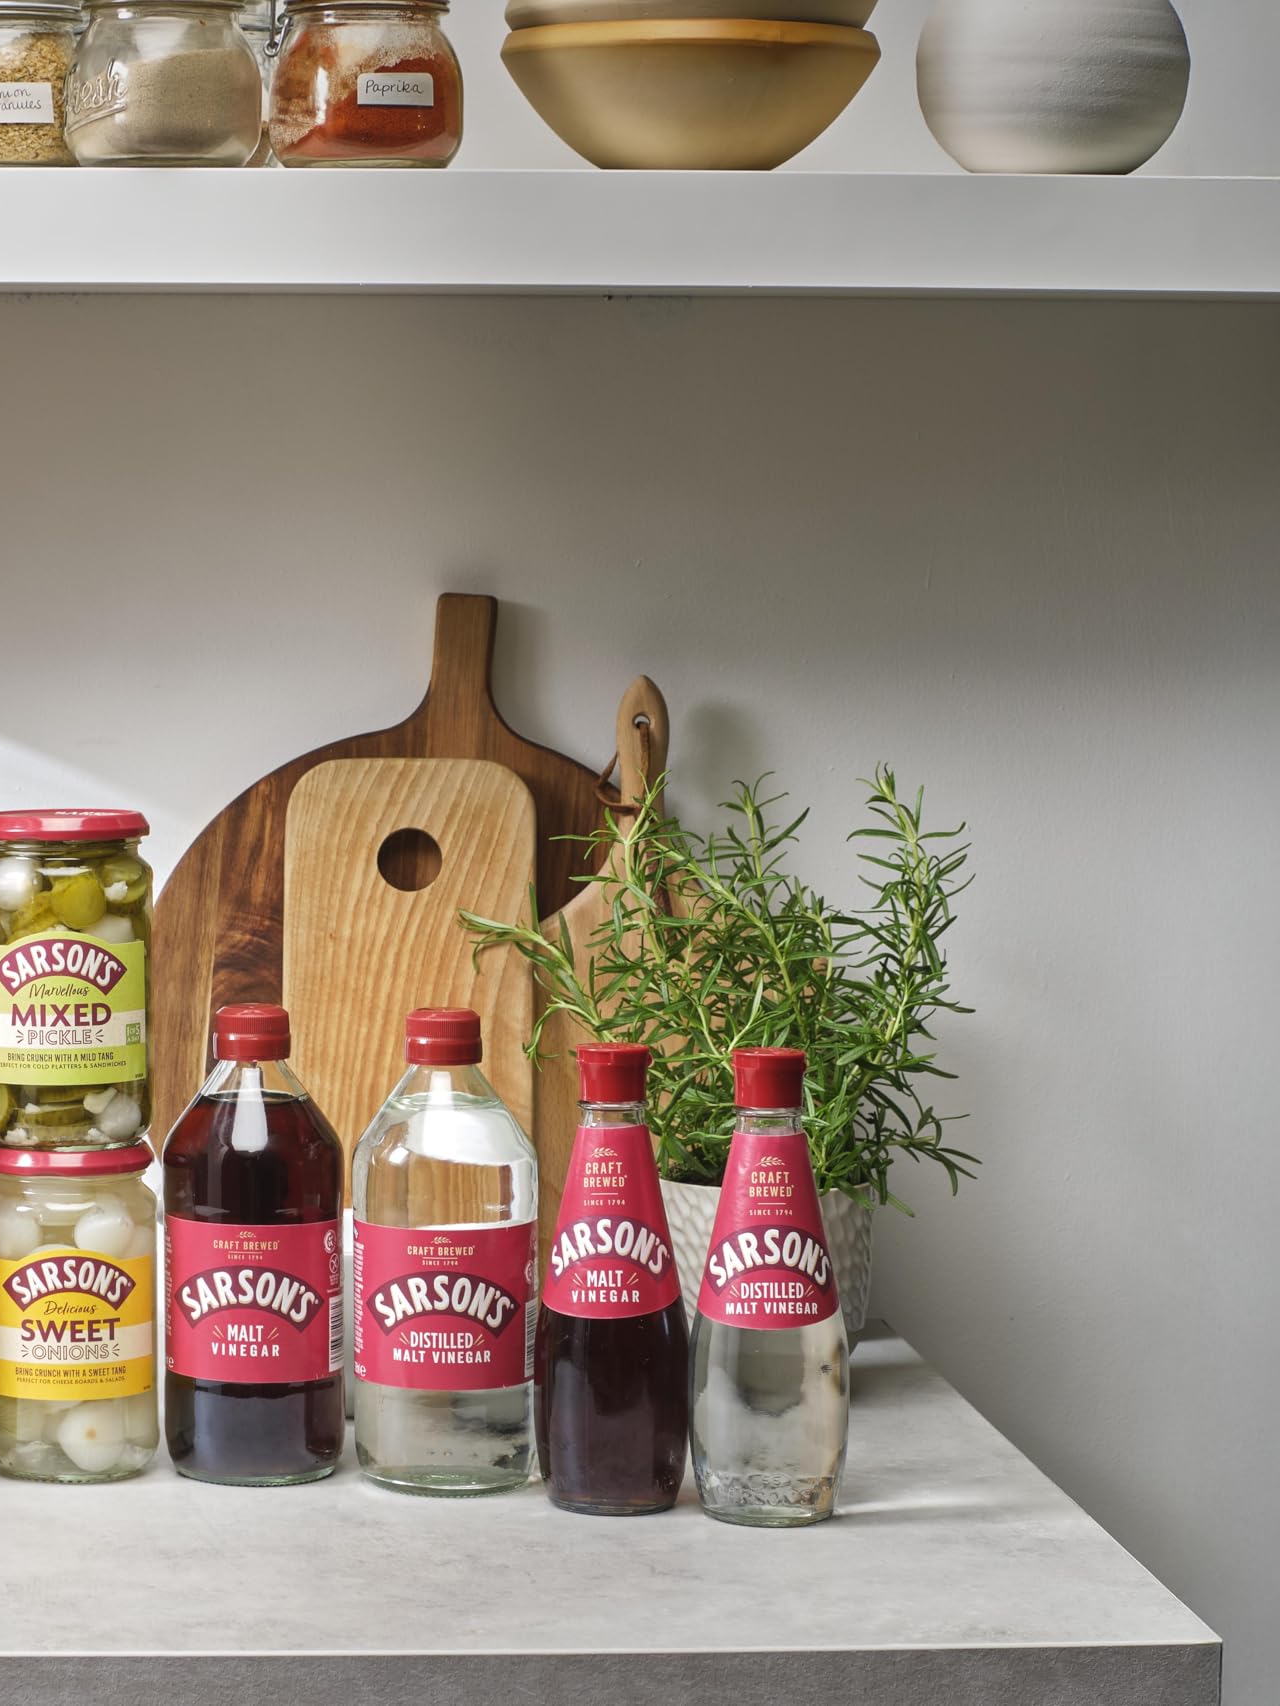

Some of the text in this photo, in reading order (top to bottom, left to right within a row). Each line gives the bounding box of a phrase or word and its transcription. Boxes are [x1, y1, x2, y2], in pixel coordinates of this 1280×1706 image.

[366, 80, 423, 96] Paprika
[1, 942, 118, 988] SARSON'S
[29, 983, 90, 999] Marvellous
[11, 1003, 111, 1027] MIXED
[28, 1029, 93, 1045] PICKLE
[8, 1053, 25, 1061] BRING
[27, 1053, 53, 1062] CRUNCH
[55, 1053, 72, 1062] WITH
[80, 1053, 96, 1061] MILD
[98, 1052, 114, 1060] TANG
[585, 1162, 623, 1175] CRAFT
[584, 1176, 625, 1188] BREWED
[751, 1171, 789, 1184] CRAFT
[749, 1186, 792, 1198] BREWED
[213, 1240, 278, 1250] CRAFT BREWED
[407, 1245, 474, 1256] CRAFT BREWED
[552, 1218, 668, 1277] SARSON'S
[709, 1228, 831, 1287] SARSON'S
[12, 1259, 127, 1303] SARSON'S
[587, 1270, 623, 1287] MALT
[182, 1269, 315, 1322] SARSON'S
[572, 1290, 639, 1302] VINEGAR
[741, 1282, 804, 1299] DISTILLED
[44, 1301, 97, 1315] Delicious
[375, 1275, 511, 1328] SARSON'S
[726, 1302, 818, 1314] MALT VINEGAR
[21, 1318, 120, 1343] SWEET
[227, 1324, 263, 1342] MALT
[411, 1331, 473, 1349] DISTILLED
[32, 1344, 110, 1360] ONIONS
[211, 1343, 279, 1357] VINEGAR
[393, 1348, 490, 1363] MALT VINEGAR
[16, 1367, 33, 1376] BRING
[35, 1368, 61, 1377] CRUNCH
[63, 1369, 80, 1377] WITH
[88, 1367, 109, 1377] SWEET
[112, 1366, 126, 1374] TANG
